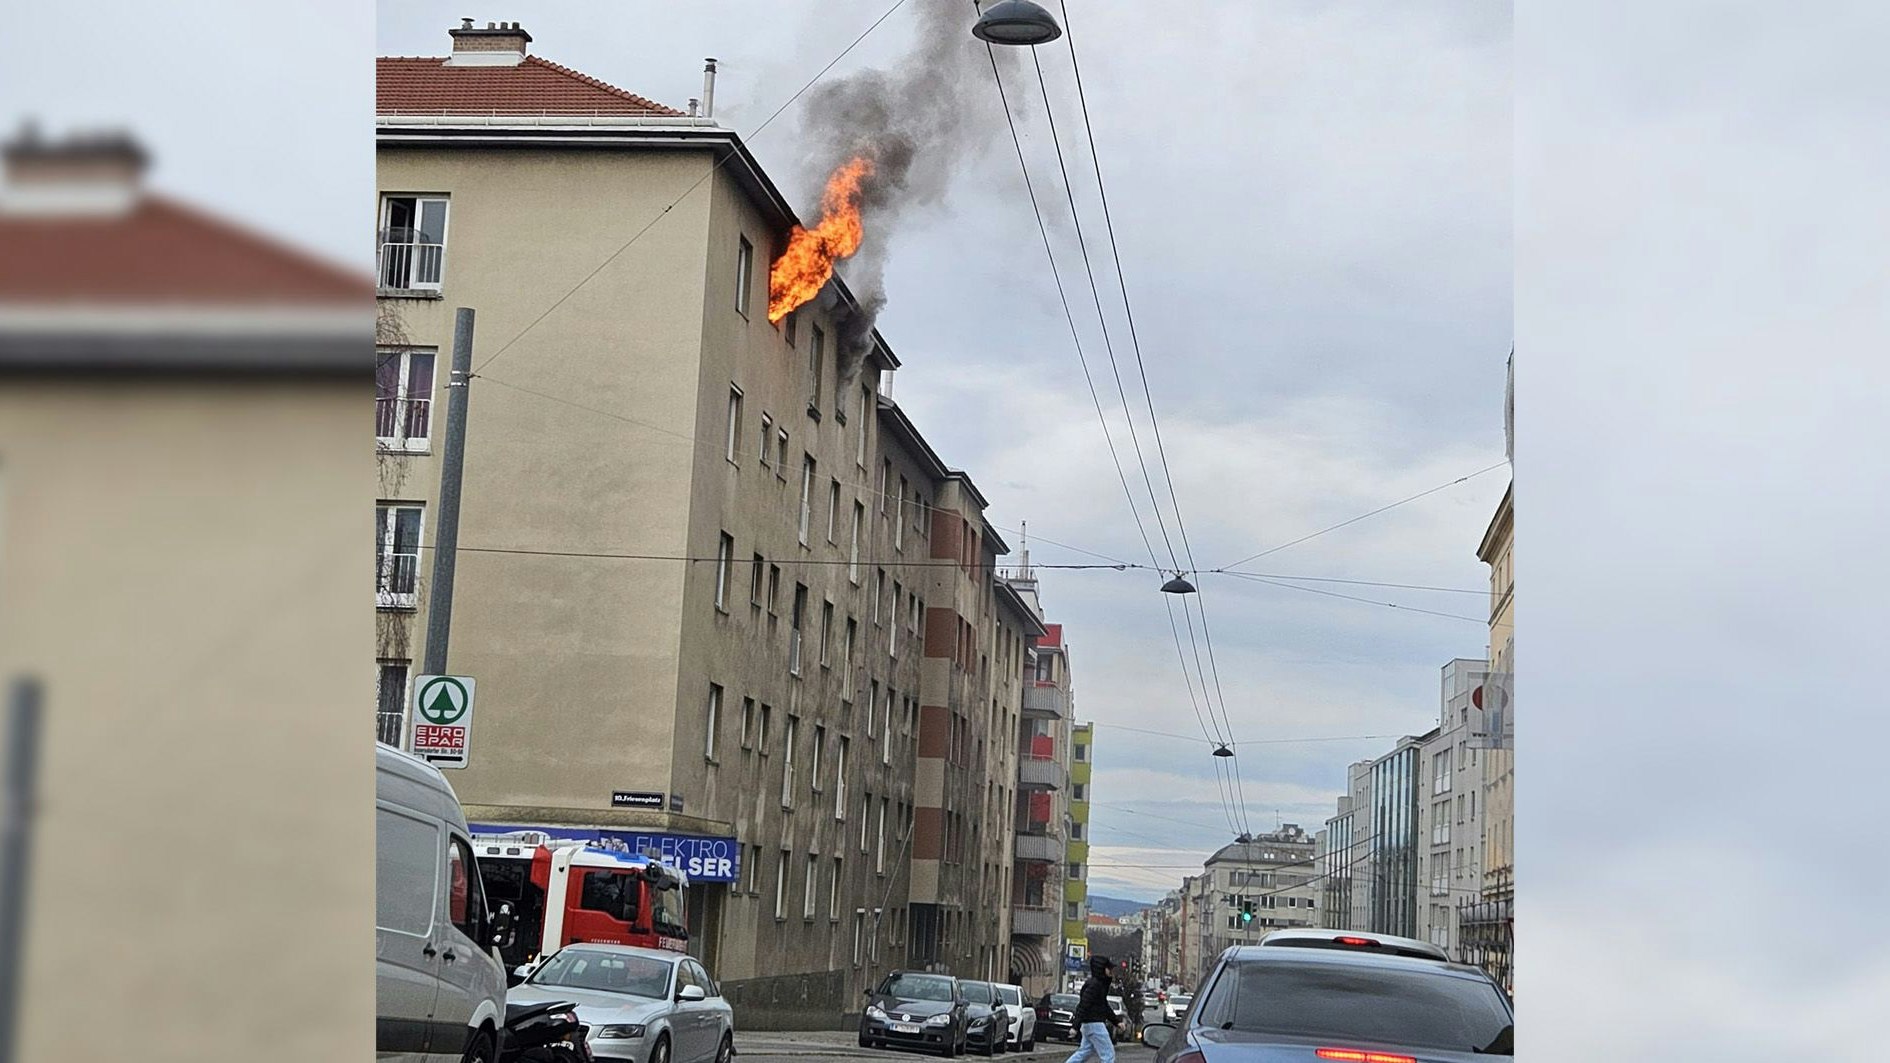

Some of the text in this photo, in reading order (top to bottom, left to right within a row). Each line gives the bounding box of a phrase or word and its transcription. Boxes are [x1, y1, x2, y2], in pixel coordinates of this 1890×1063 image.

[416, 727, 464, 737] EURO
[416, 736, 463, 746] SPAR
[636, 836, 728, 859] ELEKTRO
